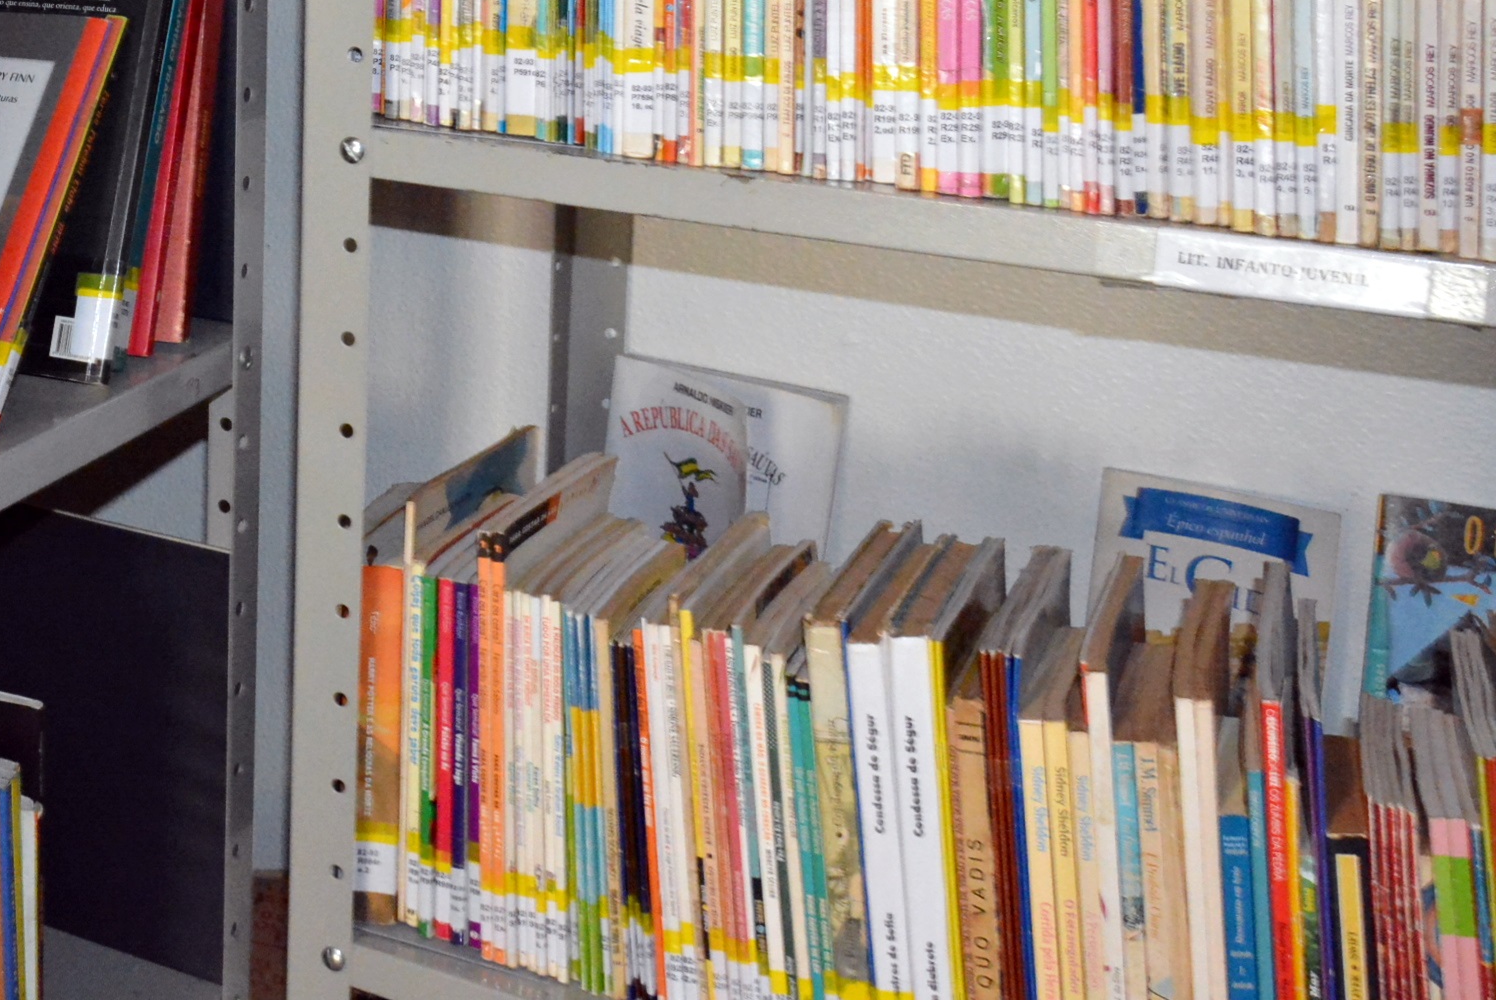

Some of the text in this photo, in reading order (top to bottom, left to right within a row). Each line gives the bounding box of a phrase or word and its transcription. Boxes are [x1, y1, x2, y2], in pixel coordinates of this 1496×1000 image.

[1344, 3, 1354, 143] GINCANA DA MORTE MARCOS REY
[1425, 43, 1436, 64] REY
[9, 72, 35, 83] FINN
[1425, 66, 1436, 109] MARCOS
[1177, 251, 1208, 267] LIT.
[673, 382, 708, 405] ARNALDO
[620, 399, 705, 439] A REPÚBLICA
[1165, 514, 1267, 548] Épico espanhol
[866, 713, 886, 836] Condessa de Ségur
[904, 715, 925, 838] Condessa de Ségur
[967, 838, 995, 990] QUO VADIS
